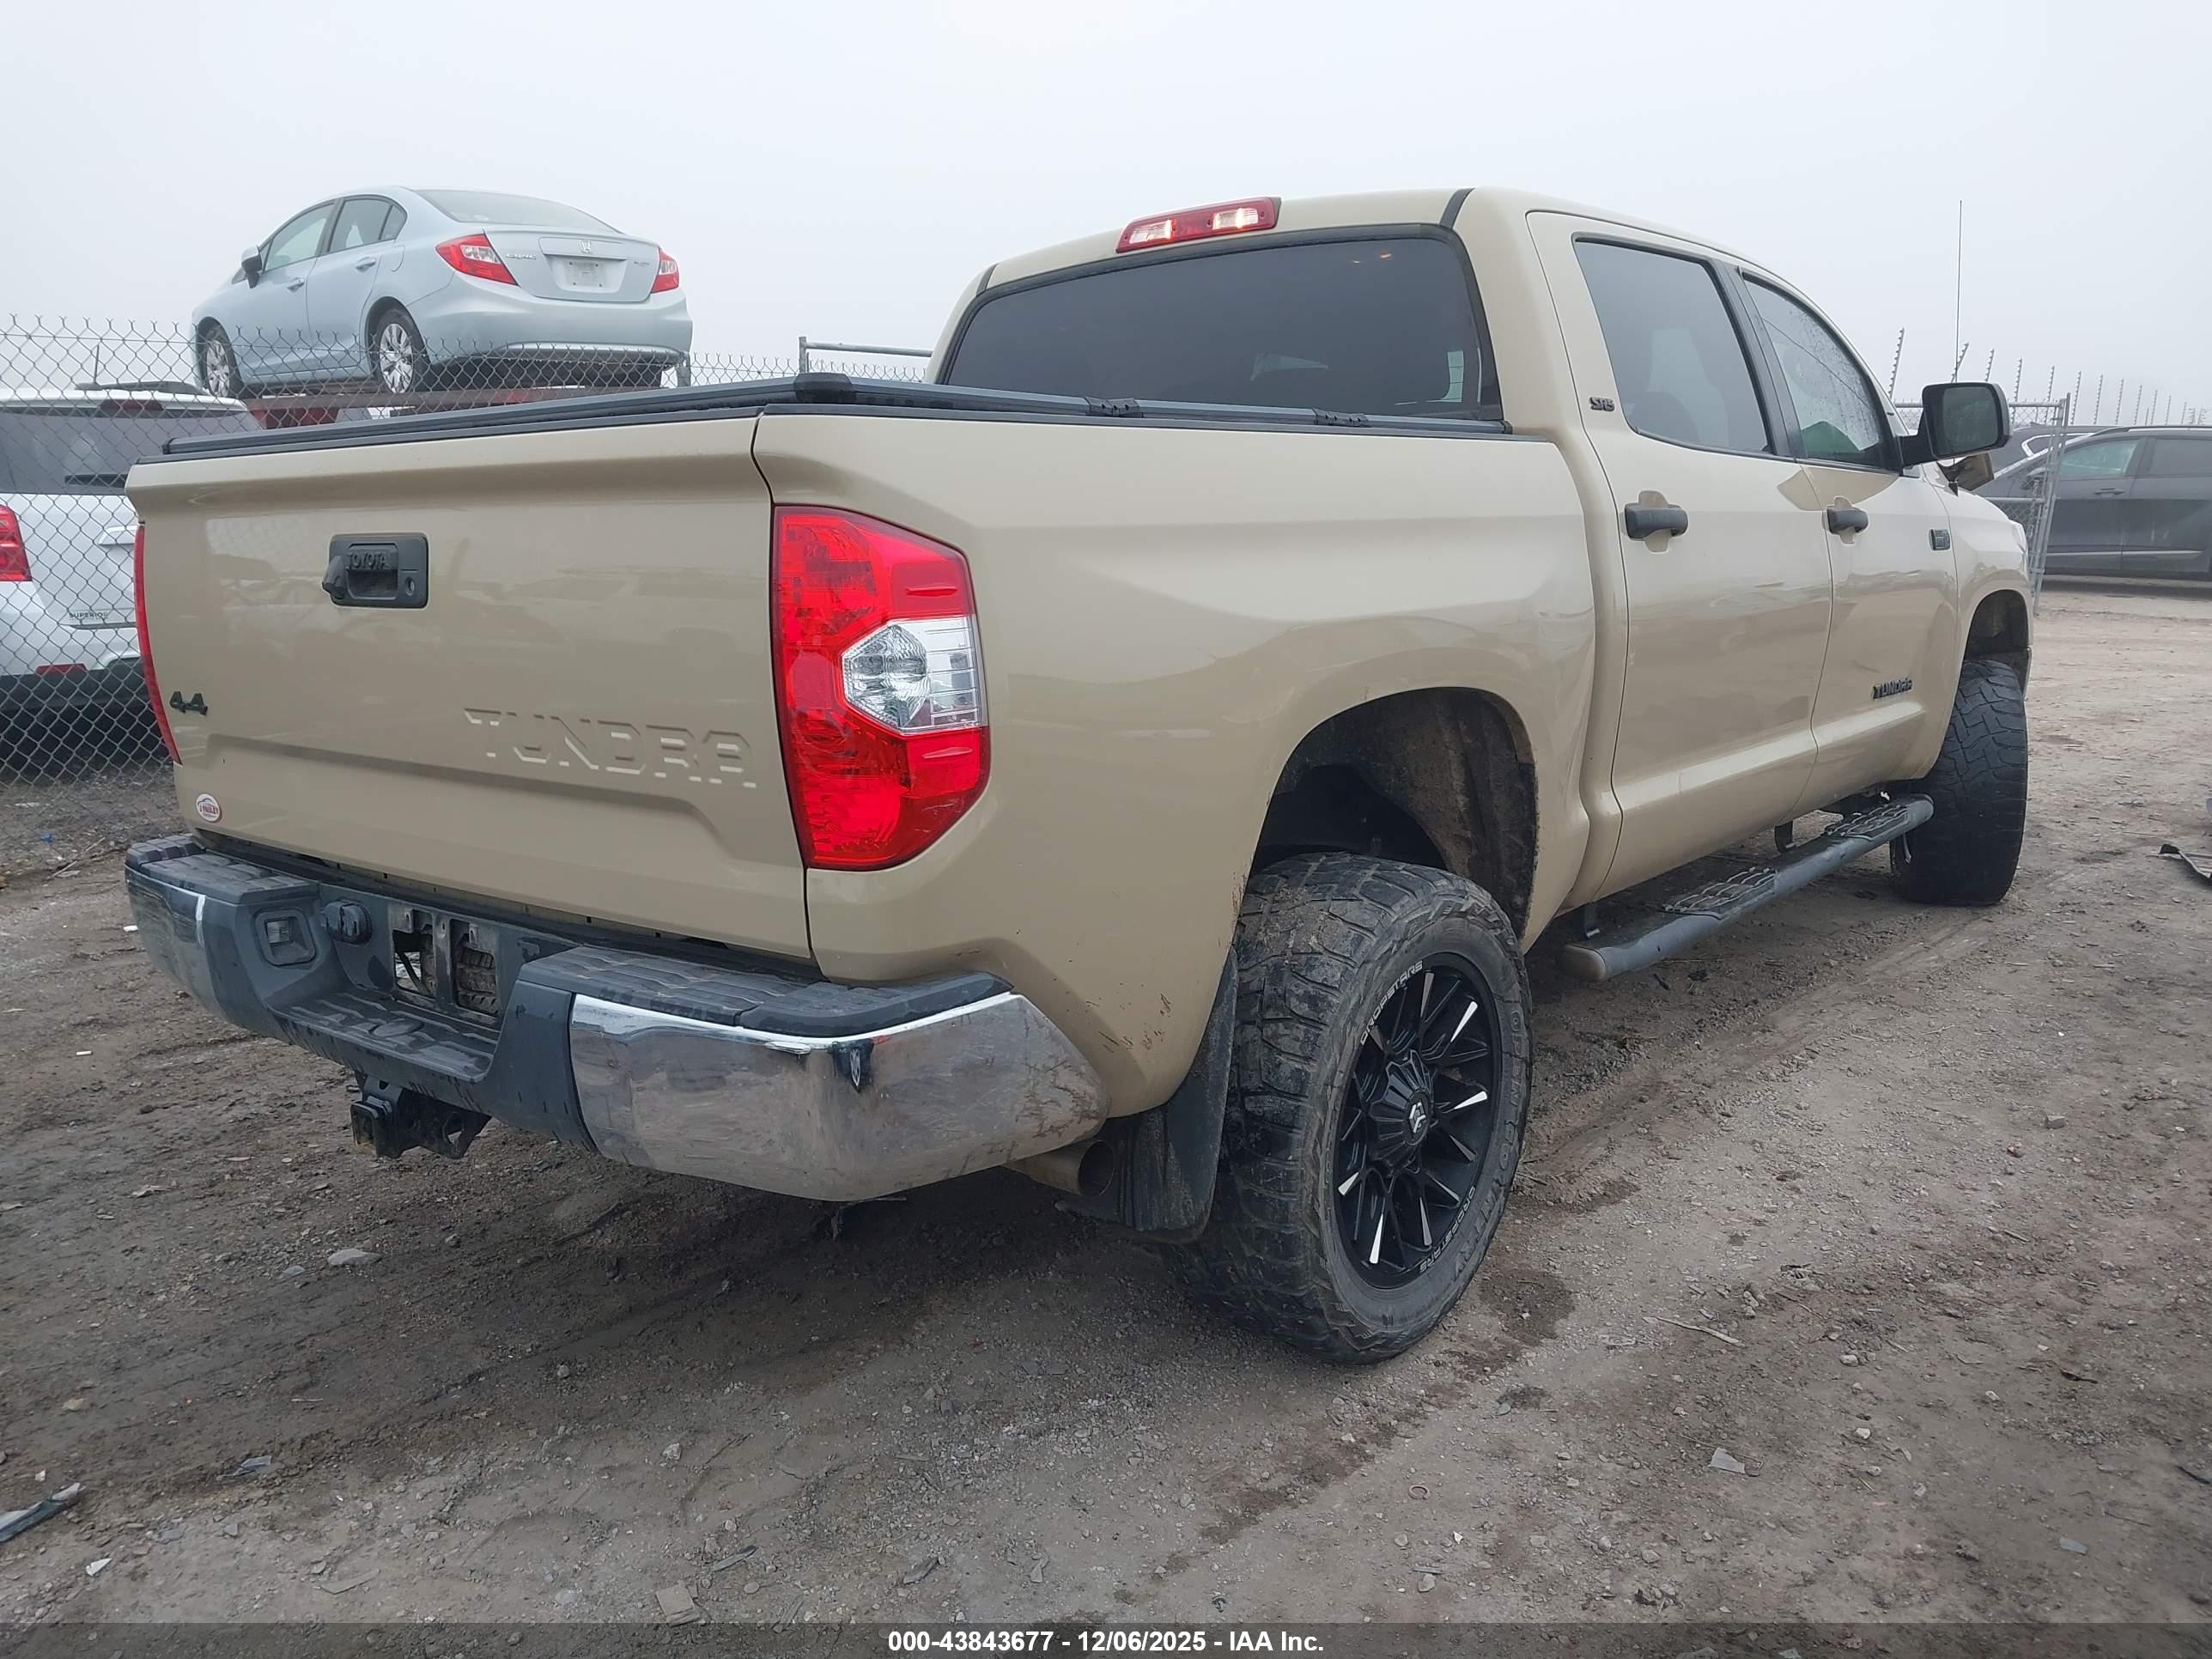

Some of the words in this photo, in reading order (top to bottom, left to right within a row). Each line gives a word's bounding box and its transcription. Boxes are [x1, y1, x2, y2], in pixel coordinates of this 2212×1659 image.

[1589, 397, 1615, 412] SR5
[345, 552, 390, 570] TOYOTA
[464, 708, 757, 789] TUNDRA
[1360, 960, 1423, 1046] DROPSTARS
[1510, 1009, 1523, 1107] OPEN
[1419, 1186, 1476, 1273] DROPSTARS
